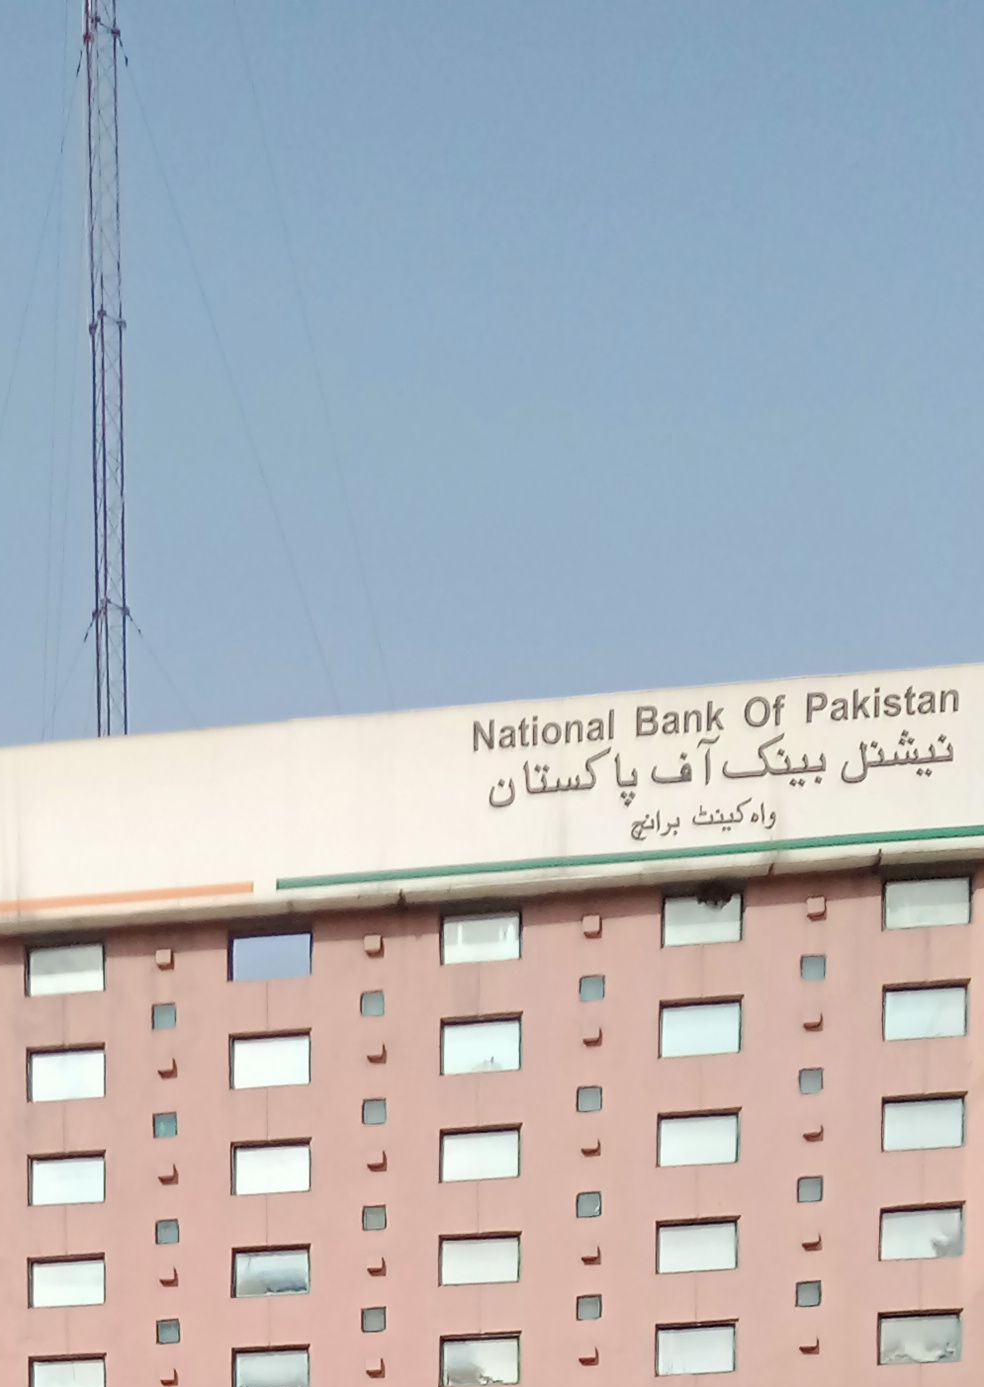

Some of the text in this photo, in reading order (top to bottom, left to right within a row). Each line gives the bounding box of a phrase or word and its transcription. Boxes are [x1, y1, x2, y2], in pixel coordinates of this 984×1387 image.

[472, 685, 960, 751] National Bank Of Pakistan
[488, 729, 954, 809] نیشنل بینک آف پاکستان
